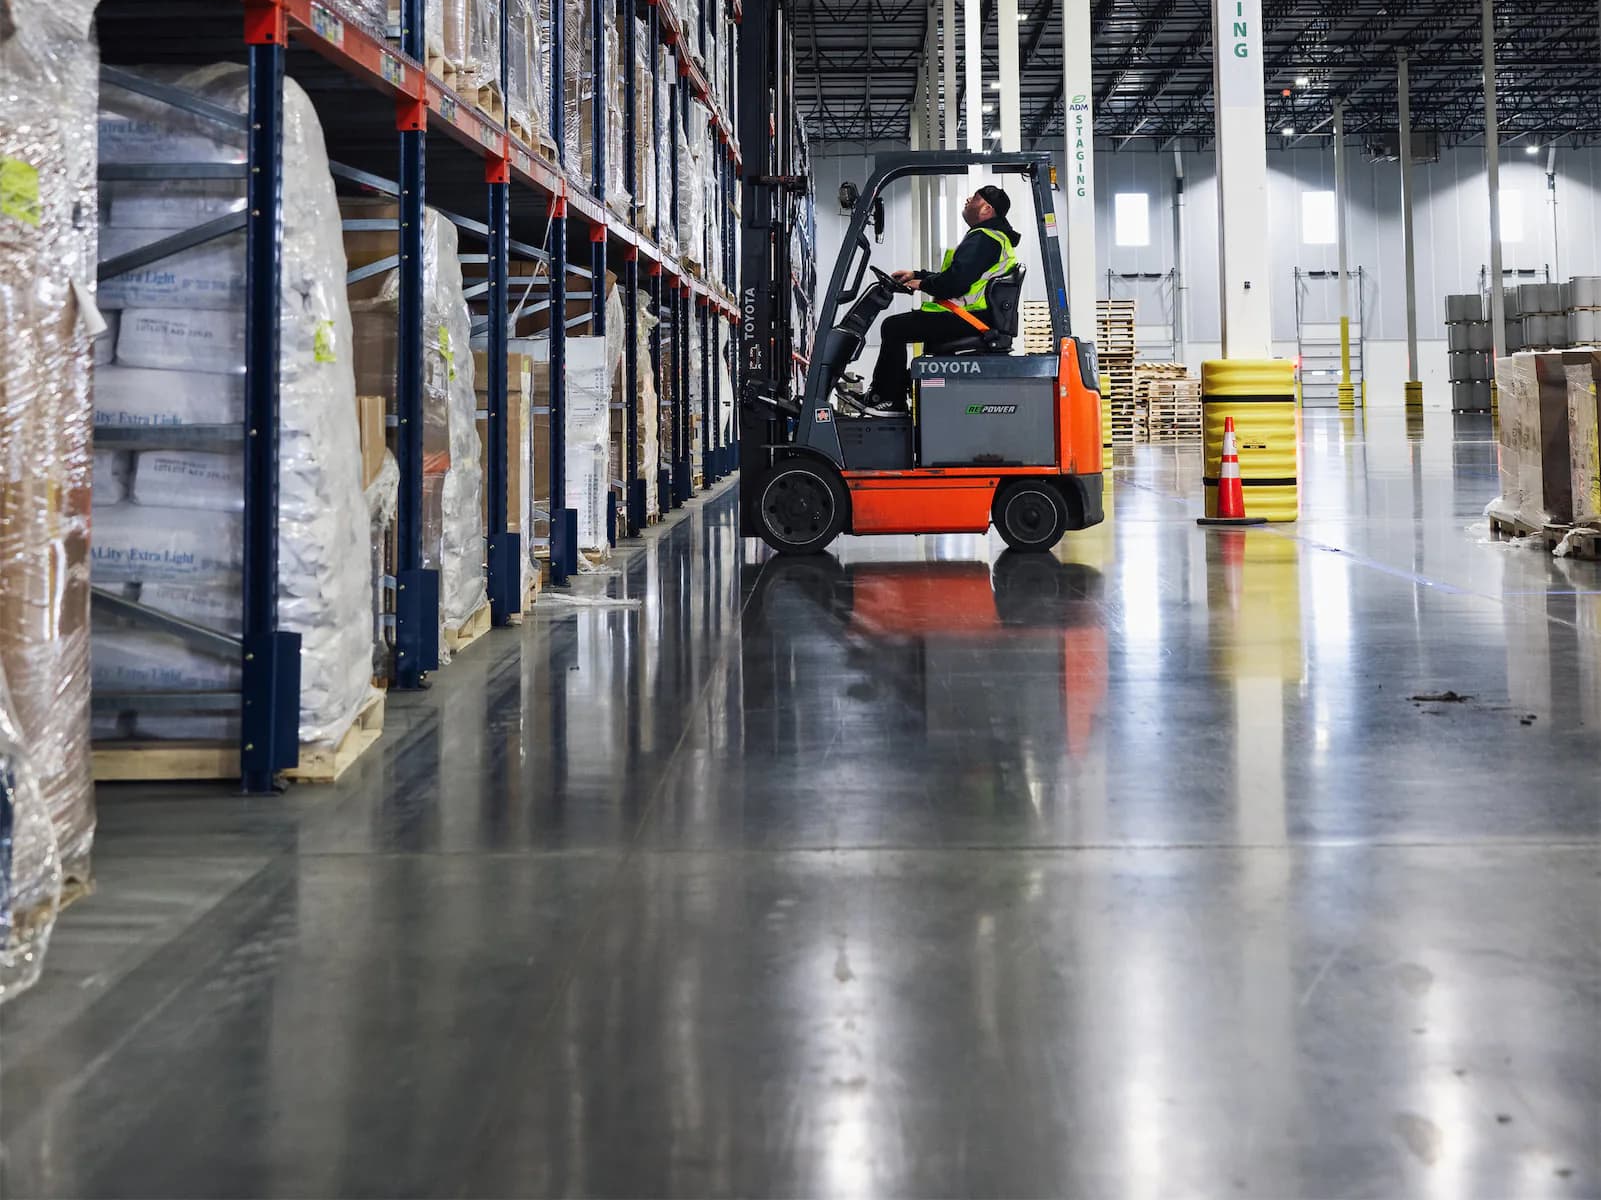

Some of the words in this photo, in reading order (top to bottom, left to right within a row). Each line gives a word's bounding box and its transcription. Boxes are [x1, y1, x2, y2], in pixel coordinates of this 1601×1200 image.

[1075, 114, 1086, 197] STAGING
[145, 271, 176, 285] Light
[744, 287, 756, 341] TOYOTA
[918, 361, 982, 374] TOYOTA
[119, 411, 150, 425] Extra
[91, 547, 121, 561] ALity
[130, 547, 162, 561] Extra
[165, 549, 195, 564] Light
